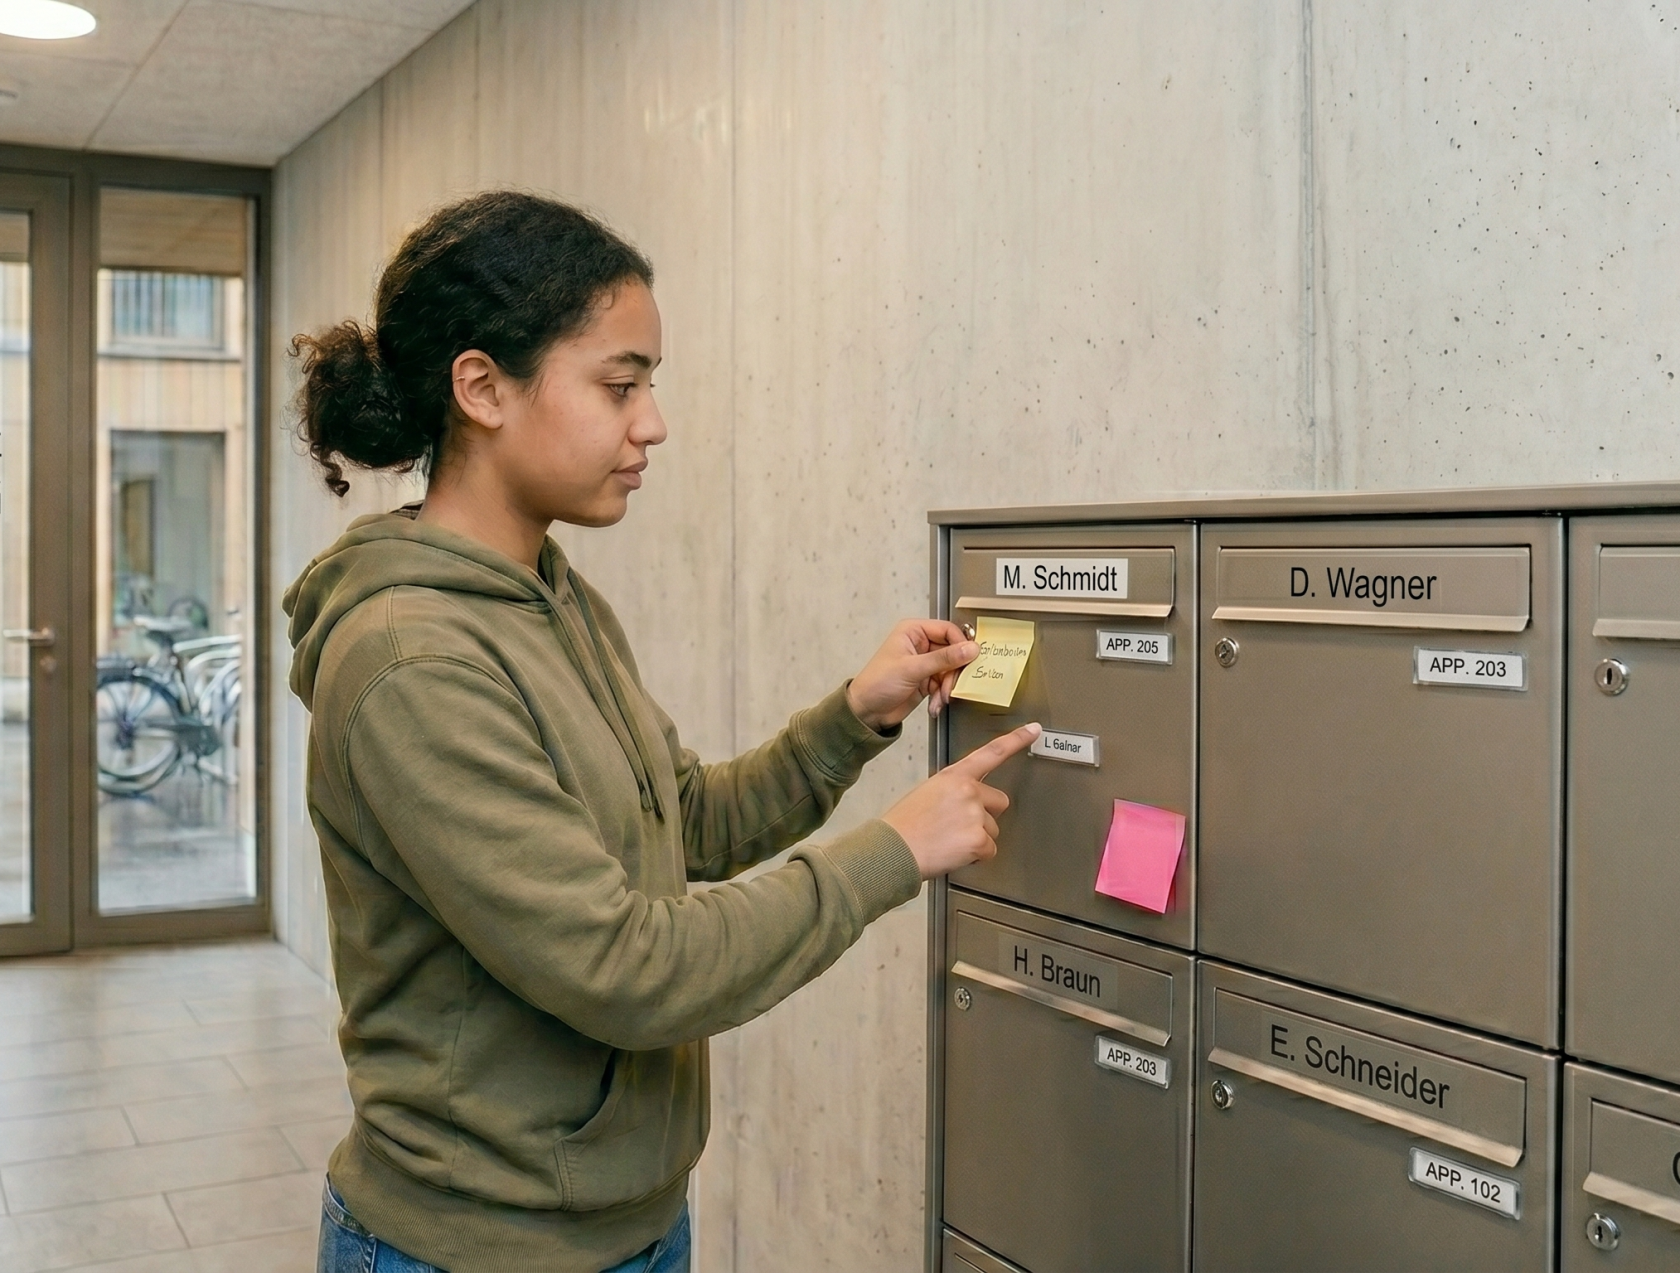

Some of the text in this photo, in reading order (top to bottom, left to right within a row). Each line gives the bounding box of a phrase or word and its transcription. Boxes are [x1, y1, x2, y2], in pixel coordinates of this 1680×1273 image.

[1003, 564, 1118, 592] M. Schmidt
[1290, 566, 1438, 608] D. Wagner
[1106, 638, 1159, 654] APP. 205
[1430, 656, 1507, 678] APP. 203
[1014, 945, 1101, 998] H. Braun
[1107, 1047, 1156, 1076] APP. 203
[1270, 1023, 1451, 1109] E. Schneider
[1425, 1161, 1501, 1204] APP. 102
